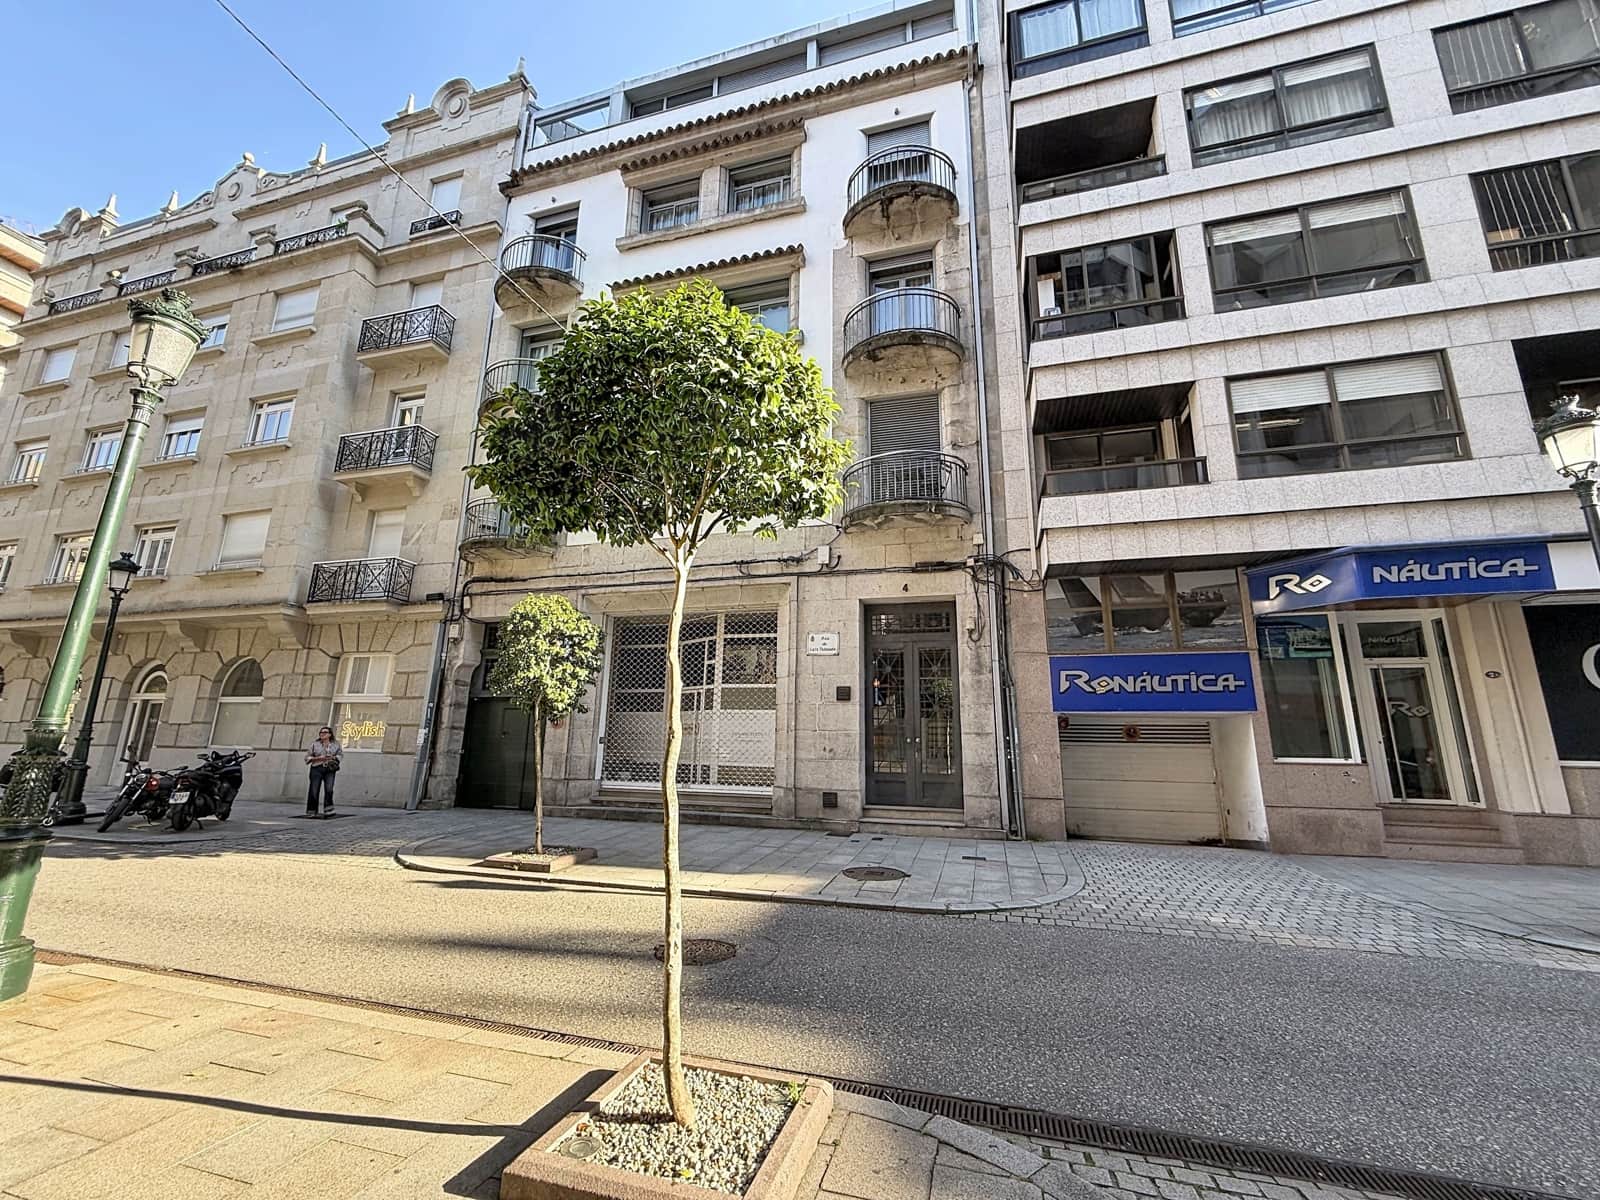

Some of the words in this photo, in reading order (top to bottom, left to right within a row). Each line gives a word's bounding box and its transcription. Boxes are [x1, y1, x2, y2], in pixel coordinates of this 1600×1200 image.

[1373, 557, 1539, 584] NÁUTICA
[902, 583, 909, 592] 4
[1059, 669, 1245, 695] RONÁUTICA
[341, 720, 386, 741] Stylish
